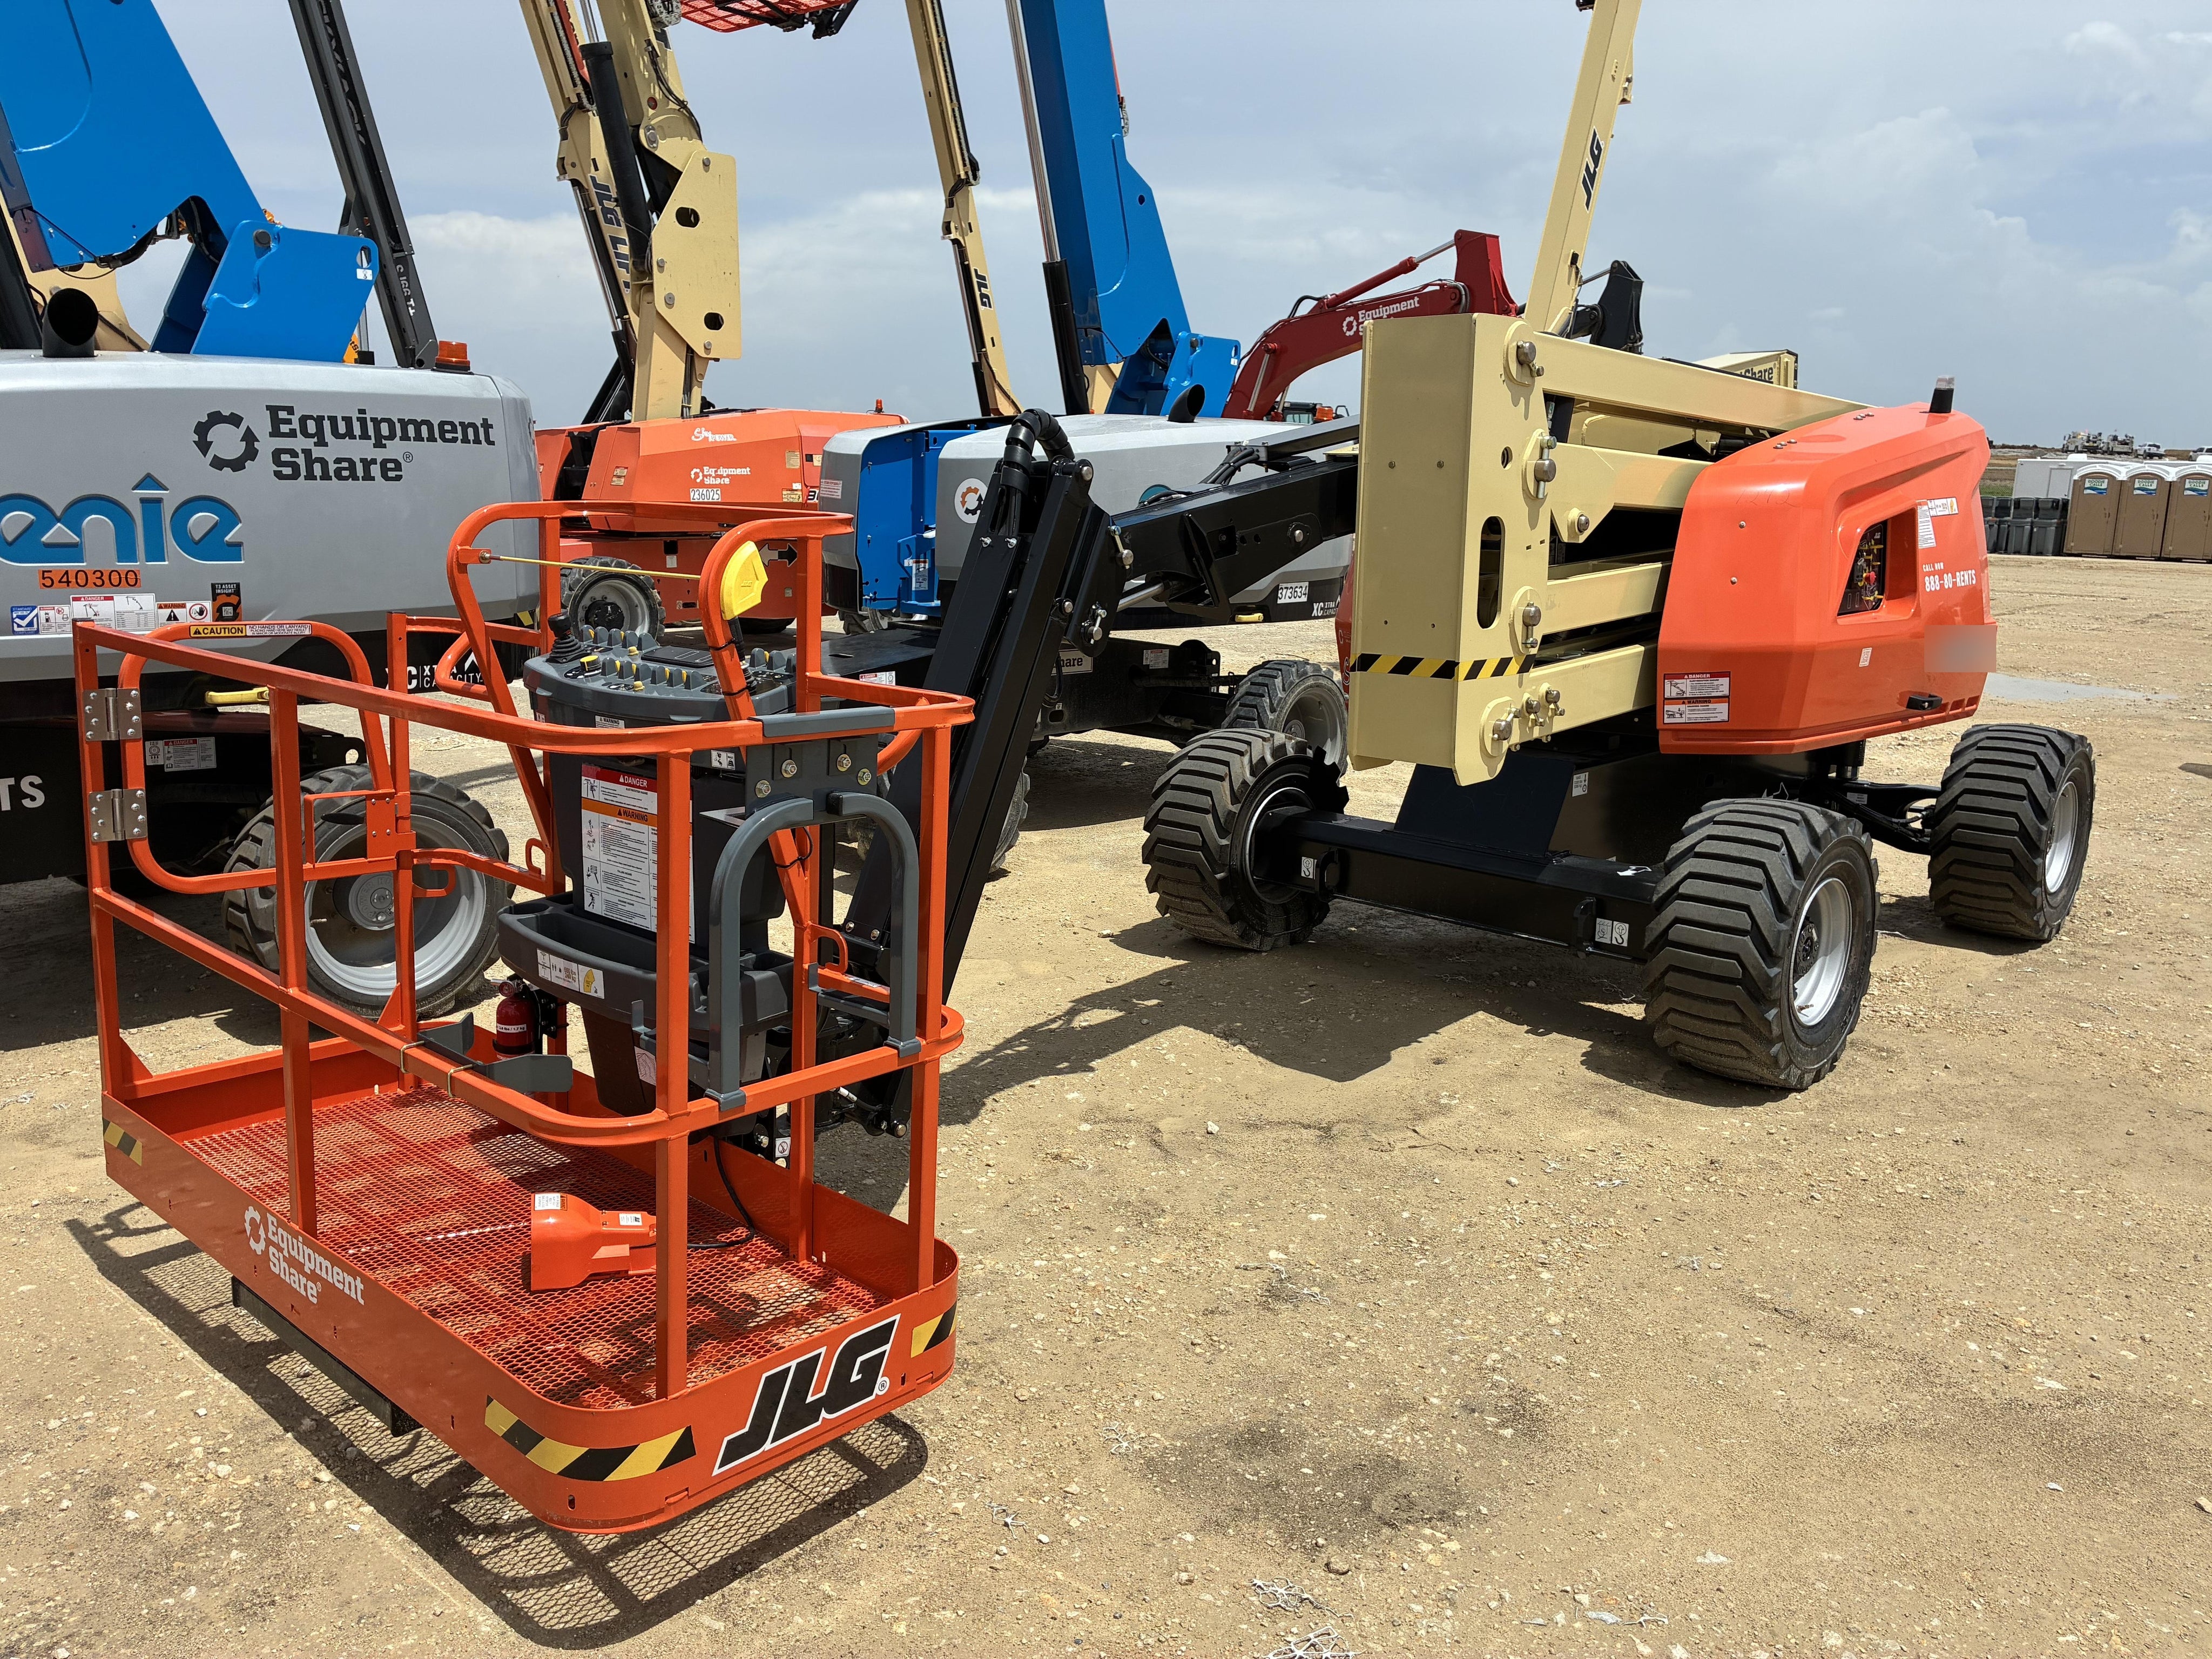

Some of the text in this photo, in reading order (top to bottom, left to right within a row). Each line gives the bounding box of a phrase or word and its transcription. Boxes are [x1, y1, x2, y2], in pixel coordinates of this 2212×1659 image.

[1581, 126, 1603, 213] JLG
[973, 267, 993, 310] JLG
[1358, 296, 1420, 322] Equipment
[266, 405, 495, 449] Equipment
[703, 466, 751, 476] Equipment
[704, 476, 731, 484] Share
[691, 489, 720, 501] 236025
[1923, 562, 1944, 572] CALL NOW
[42, 570, 138, 588] 540300
[1924, 569, 1977, 592] 888-80-RENTS
[1278, 585, 1307, 600] 373634
[1312, 603, 1323, 617] XC
[203, 627, 243, 635] CAUTION
[624, 775, 648, 788] DANGER
[622, 810, 648, 822] WARNING
[267, 1213, 365, 1305] Equipment
